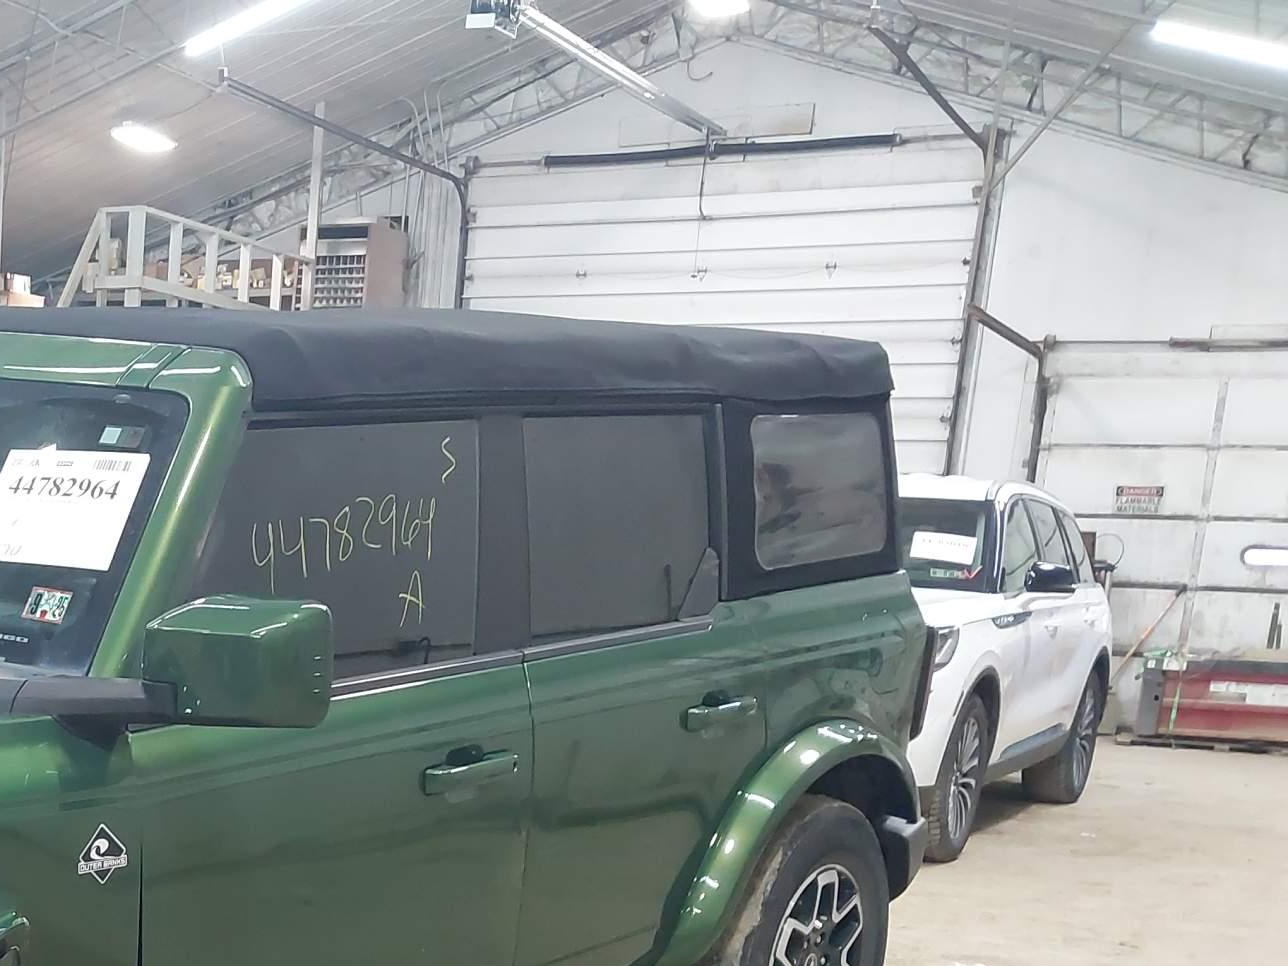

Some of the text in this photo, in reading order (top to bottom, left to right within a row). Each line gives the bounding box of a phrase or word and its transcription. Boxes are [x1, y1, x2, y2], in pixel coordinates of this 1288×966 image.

[9, 476, 121, 500] 44782964
[251, 494, 436, 595] 44782964
[398, 570, 425, 628] A
[80, 857, 127, 872] OUTER BANKS
